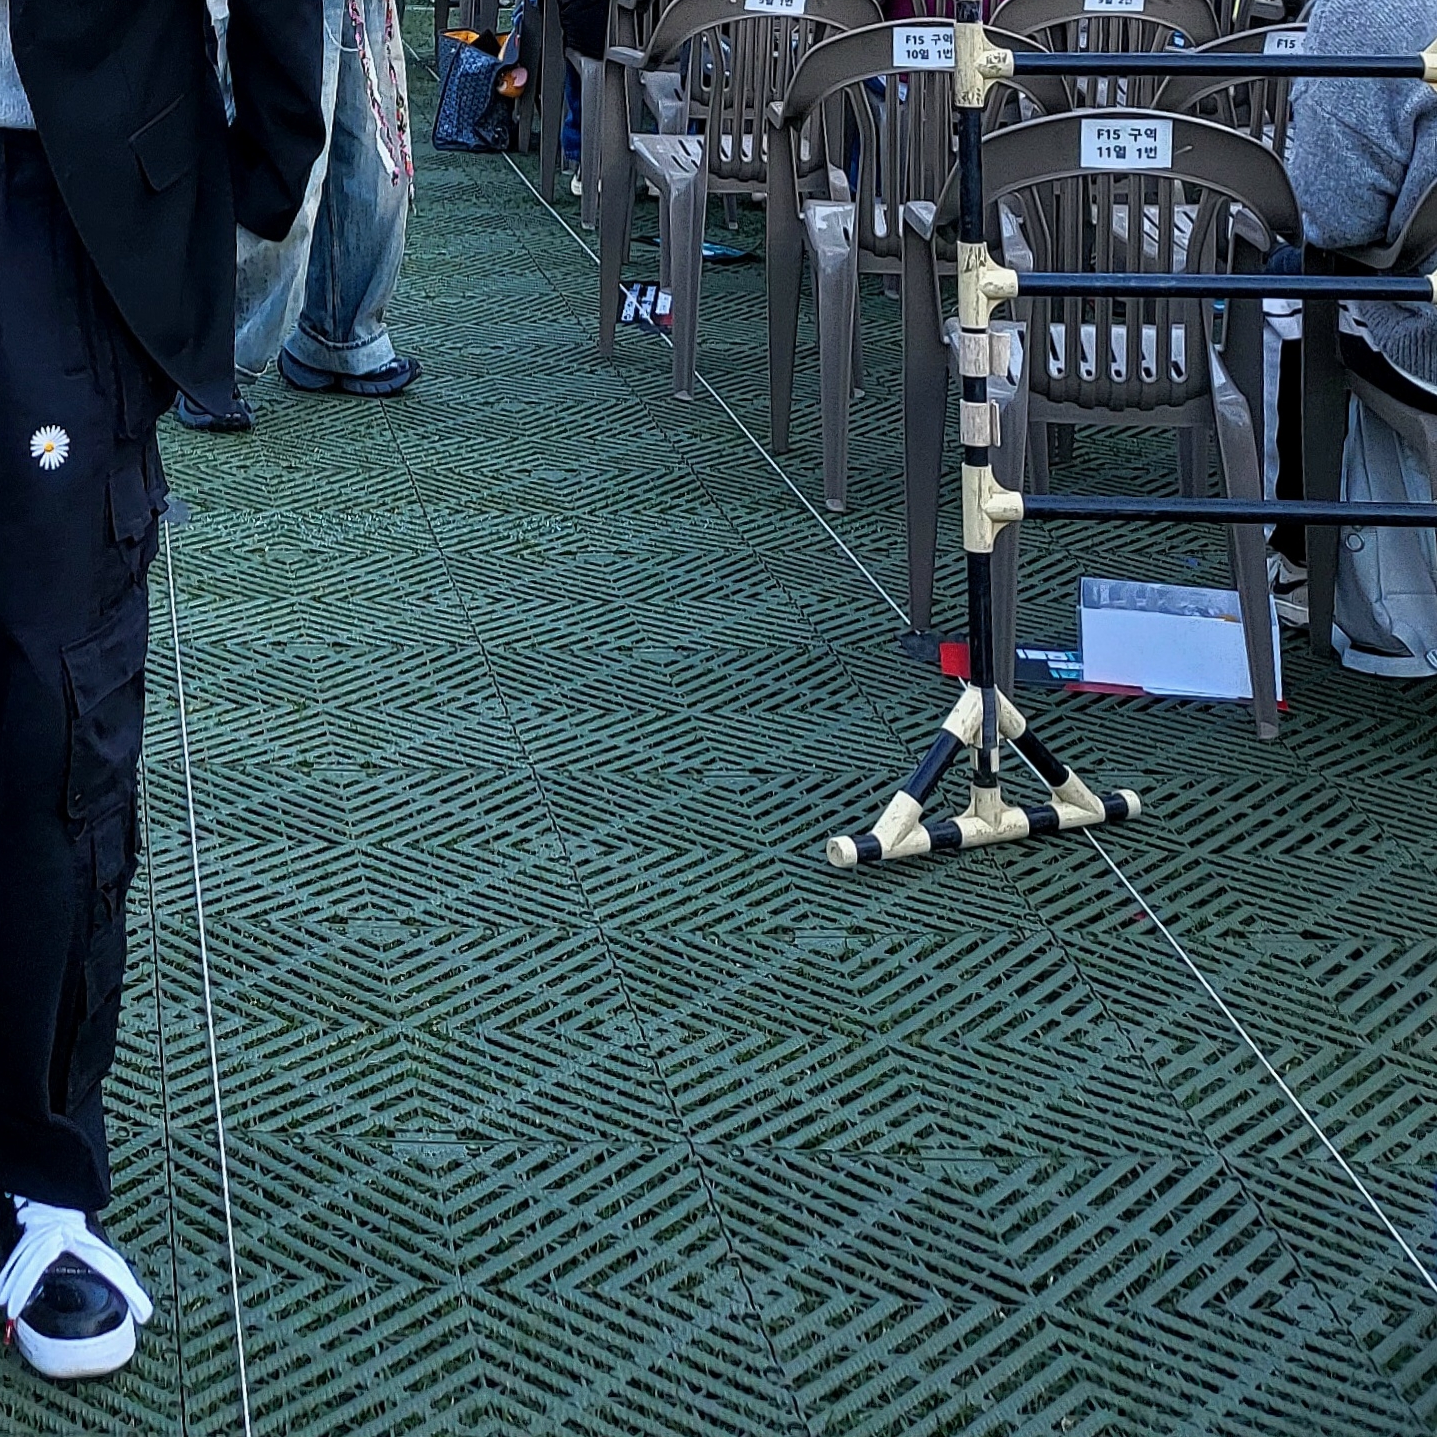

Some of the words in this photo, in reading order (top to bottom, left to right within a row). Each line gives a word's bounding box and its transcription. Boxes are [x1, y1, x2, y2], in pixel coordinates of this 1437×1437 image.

[905, 34, 925, 45] F15
[931, 33, 953, 46] 구역
[1276, 38, 1297, 49] F15
[906, 48, 930, 60] 10열
[937, 47, 953, 60] 1번
[1096, 128, 1121, 141] F15
[1127, 127, 1158, 143] 구역
[1096, 145, 1127, 160] 11열
[1136, 145, 1158, 160] 1번
